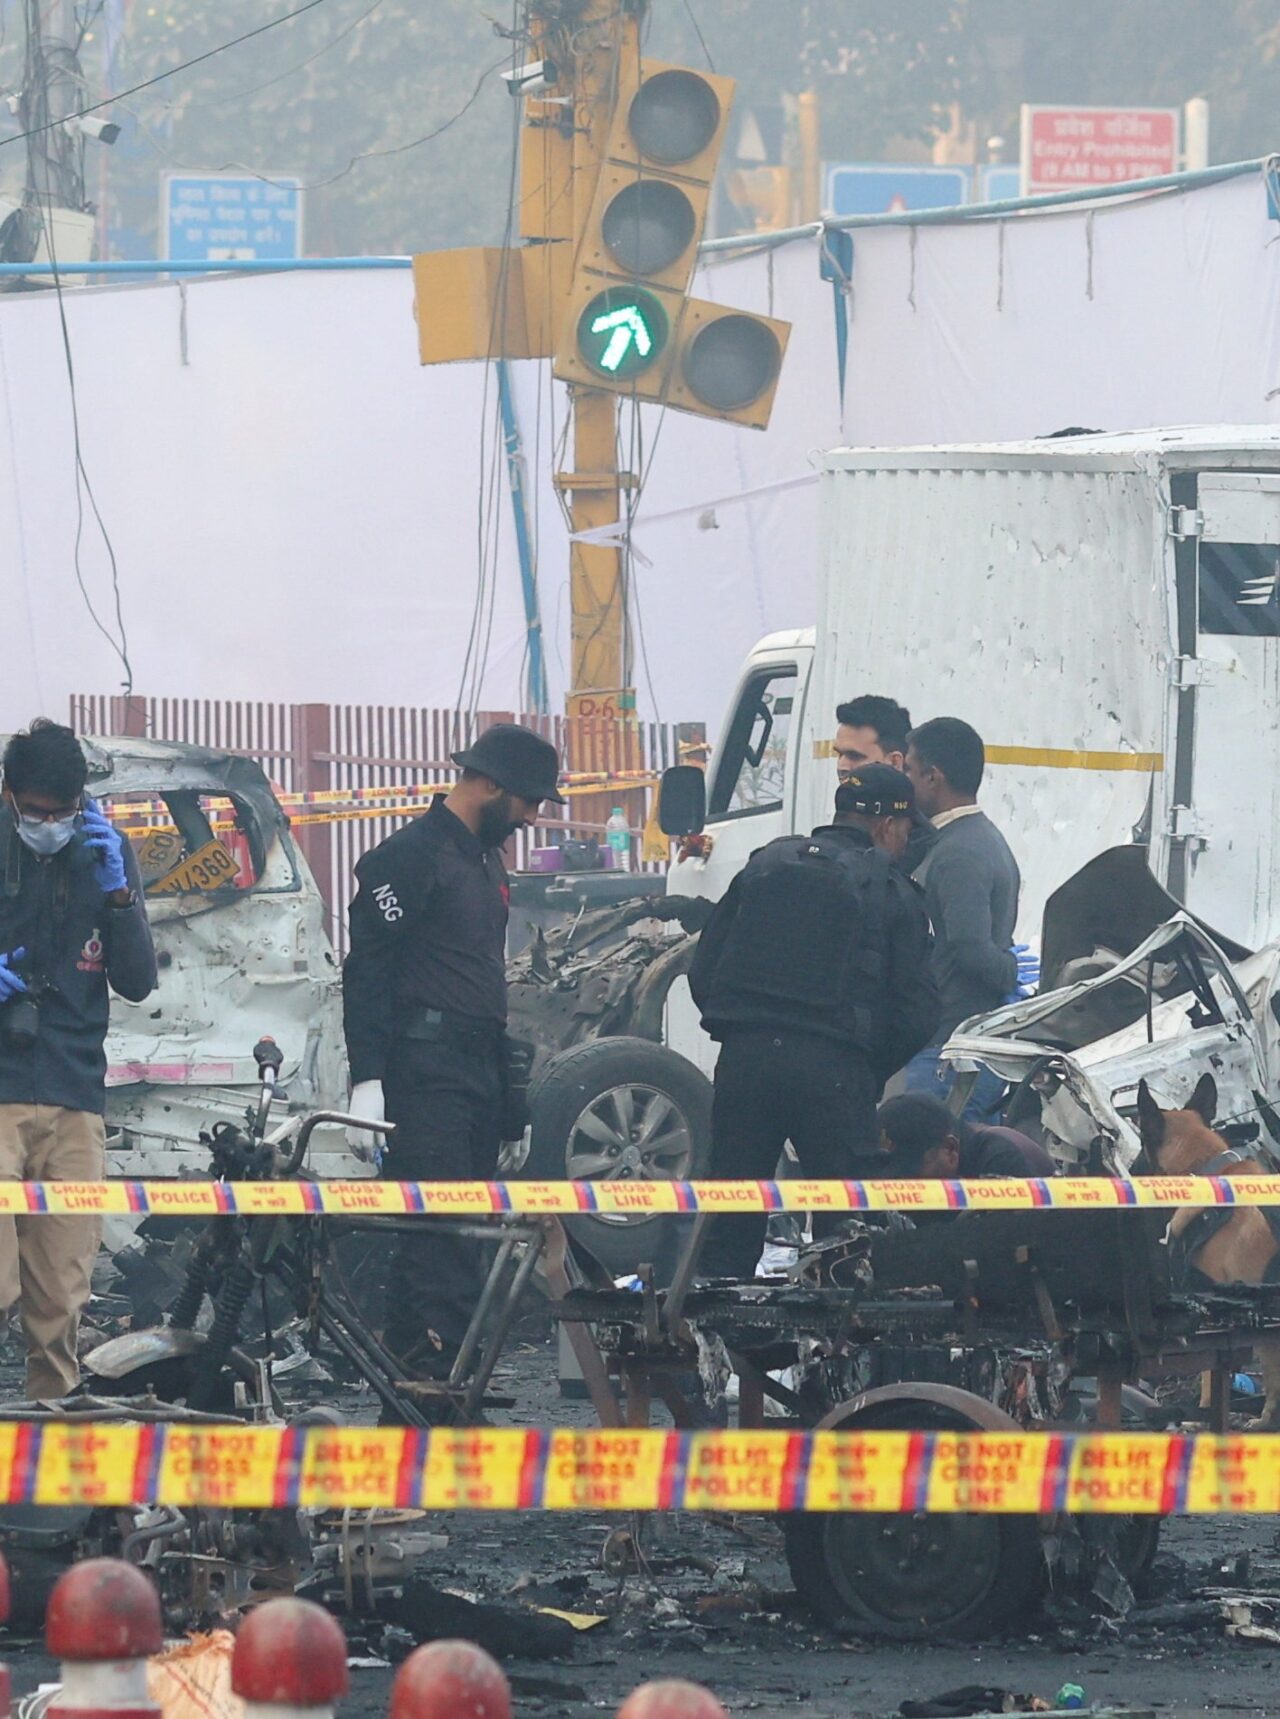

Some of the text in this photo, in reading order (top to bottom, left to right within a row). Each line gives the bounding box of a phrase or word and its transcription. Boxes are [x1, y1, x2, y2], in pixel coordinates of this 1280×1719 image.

[1035, 139, 1080, 160] Entry
[372, 884, 403, 922] NSG
[150, 1191, 211, 1204] POLICE
[426, 1190, 486, 1203] POLICE
[615, 1195, 653, 1207] LINE
[697, 1189, 758, 1202] POLICE
[885, 1192, 924, 1205] LINE
[968, 1186, 1028, 1199] POLICE
[1152, 1188, 1192, 1201] LINE
[65, 1196, 104, 1209] LINE
[341, 1196, 380, 1208] LINE
[171, 1435, 255, 1450] DO NOT
[555, 1438, 640, 1456] DO NOT
[939, 1441, 1026, 1459] DO NOT
[316, 1443, 385, 1462] DELHI
[700, 1447, 768, 1466] DELHI
[1082, 1450, 1150, 1468] DELHI
[173, 1457, 251, 1475] CROSS
[558, 1463, 635, 1479] CROSS
[942, 1463, 1019, 1482] CROSS
[187, 1480, 236, 1497] LINE
[305, 1474, 388, 1494] POLICE
[689, 1477, 771, 1497] POLICE
[1074, 1480, 1153, 1499] POLICE
[573, 1485, 619, 1504] LINE
[955, 1487, 1003, 1505] LINE
